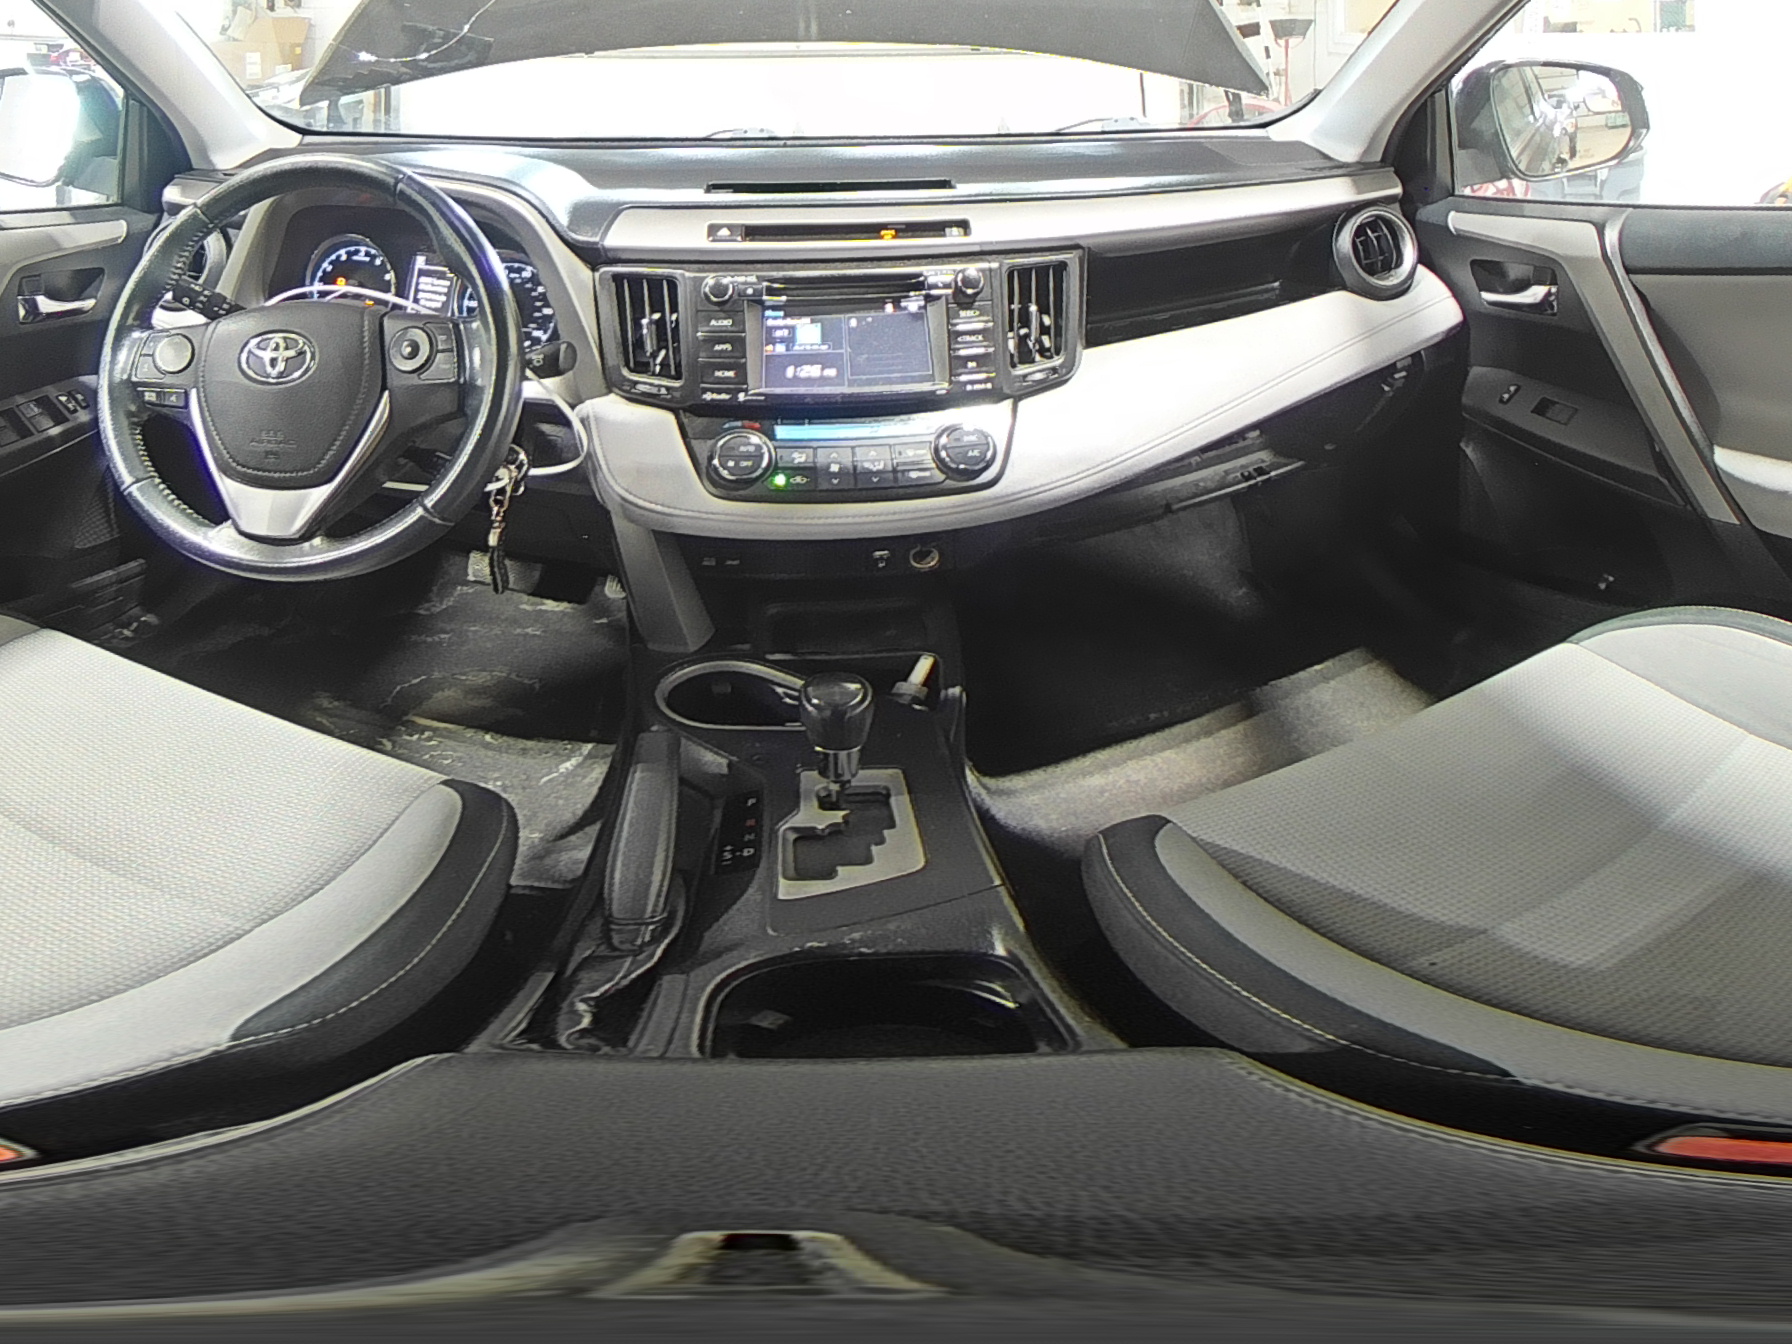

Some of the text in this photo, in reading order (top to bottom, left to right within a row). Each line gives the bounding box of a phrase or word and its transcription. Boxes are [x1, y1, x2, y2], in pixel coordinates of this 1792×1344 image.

[709, 318, 733, 326] AUDIO
[713, 343, 733, 351] APPS
[714, 370, 737, 378] HOME
[746, 797, 757, 807] P
[742, 847, 756, 857] D
